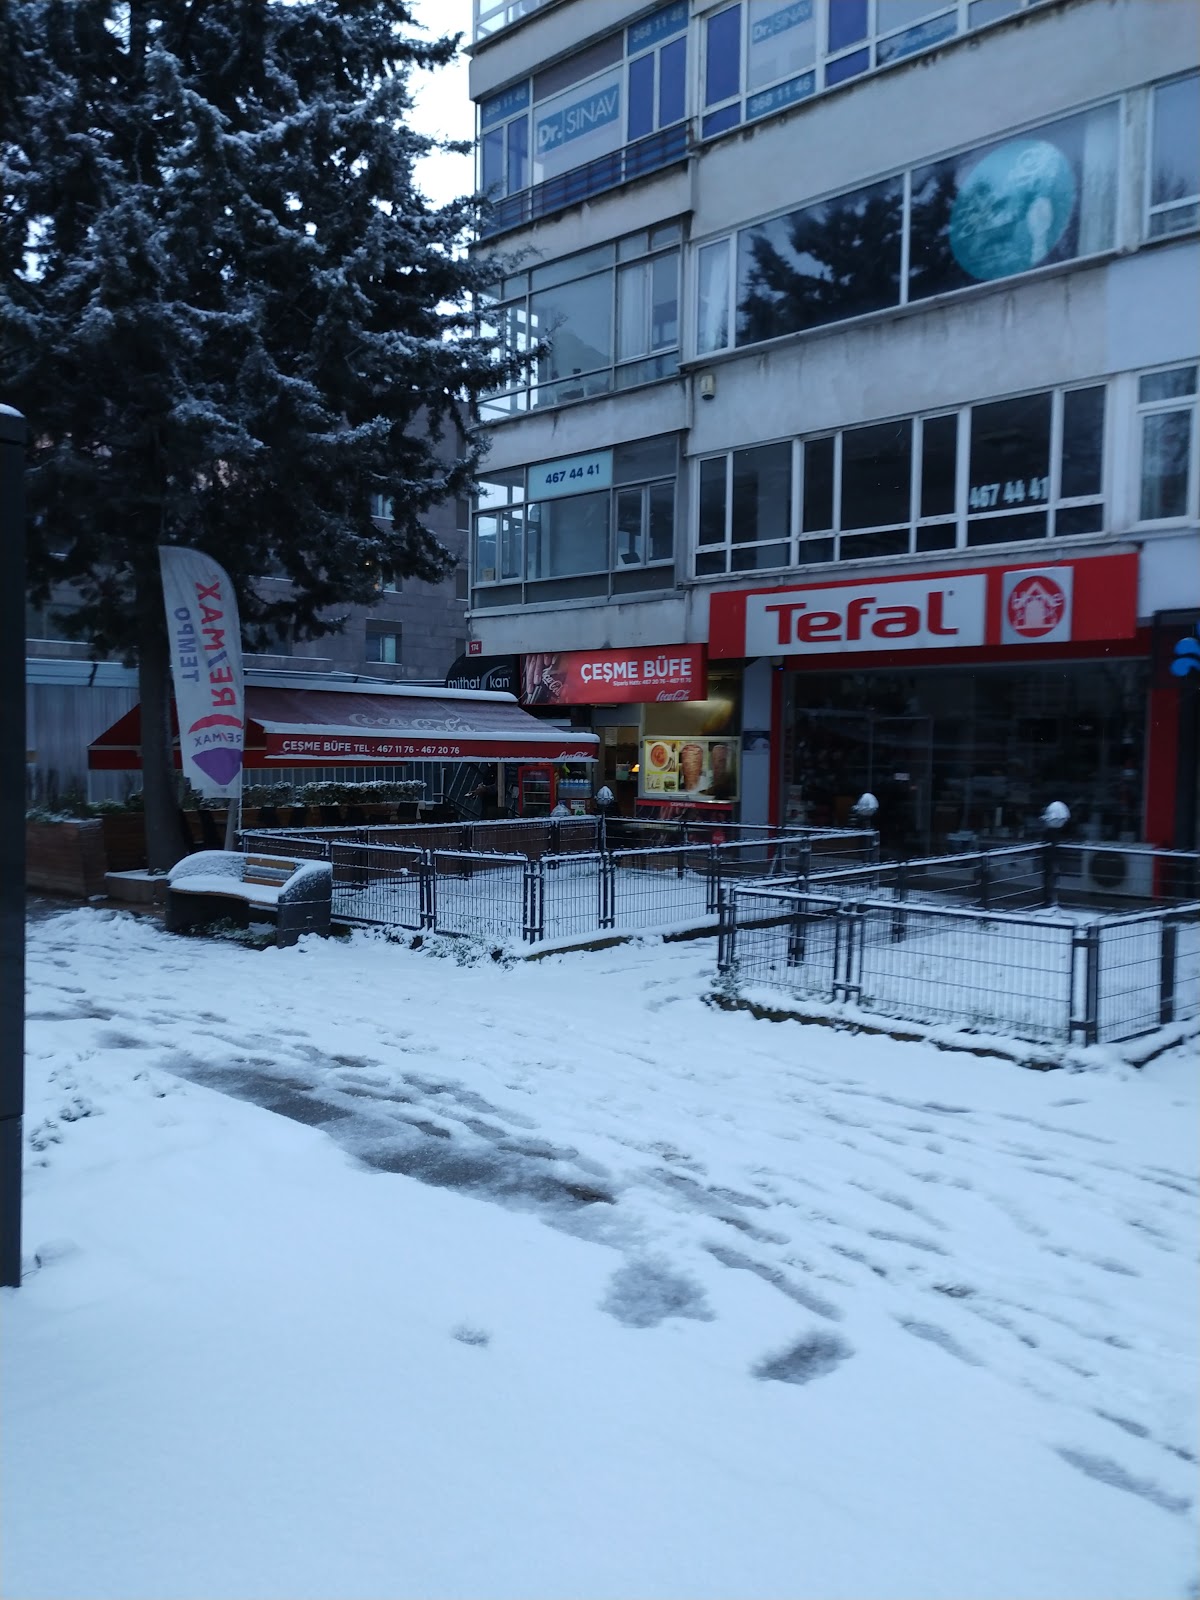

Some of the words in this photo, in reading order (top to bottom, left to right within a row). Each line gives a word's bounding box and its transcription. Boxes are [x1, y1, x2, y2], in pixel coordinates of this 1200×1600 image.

[538, 124, 563, 148] Dr.
[565, 91, 618, 134] SINAV
[545, 471, 566, 484] 467
[569, 467, 584, 479] 44
[587, 464, 600, 475] 41
[970, 483, 1001, 508] 467
[1003, 479, 1026, 503] 44
[765, 590, 959, 645] Tefal
[447, 675, 481, 689] mithat
[489, 675, 510, 688] kan
[580, 660, 639, 684] ÇEŞME
[643, 655, 692, 678] BÜFE
[282, 740, 320, 752] ÇEŞME
[323, 740, 352, 752] BÜFE
[376, 745, 393, 753] 467
[395, 745, 402, 753] 11
[404, 745, 414, 753] 76
[421, 746, 436, 754] 467
[437, 746, 449, 754] 20
